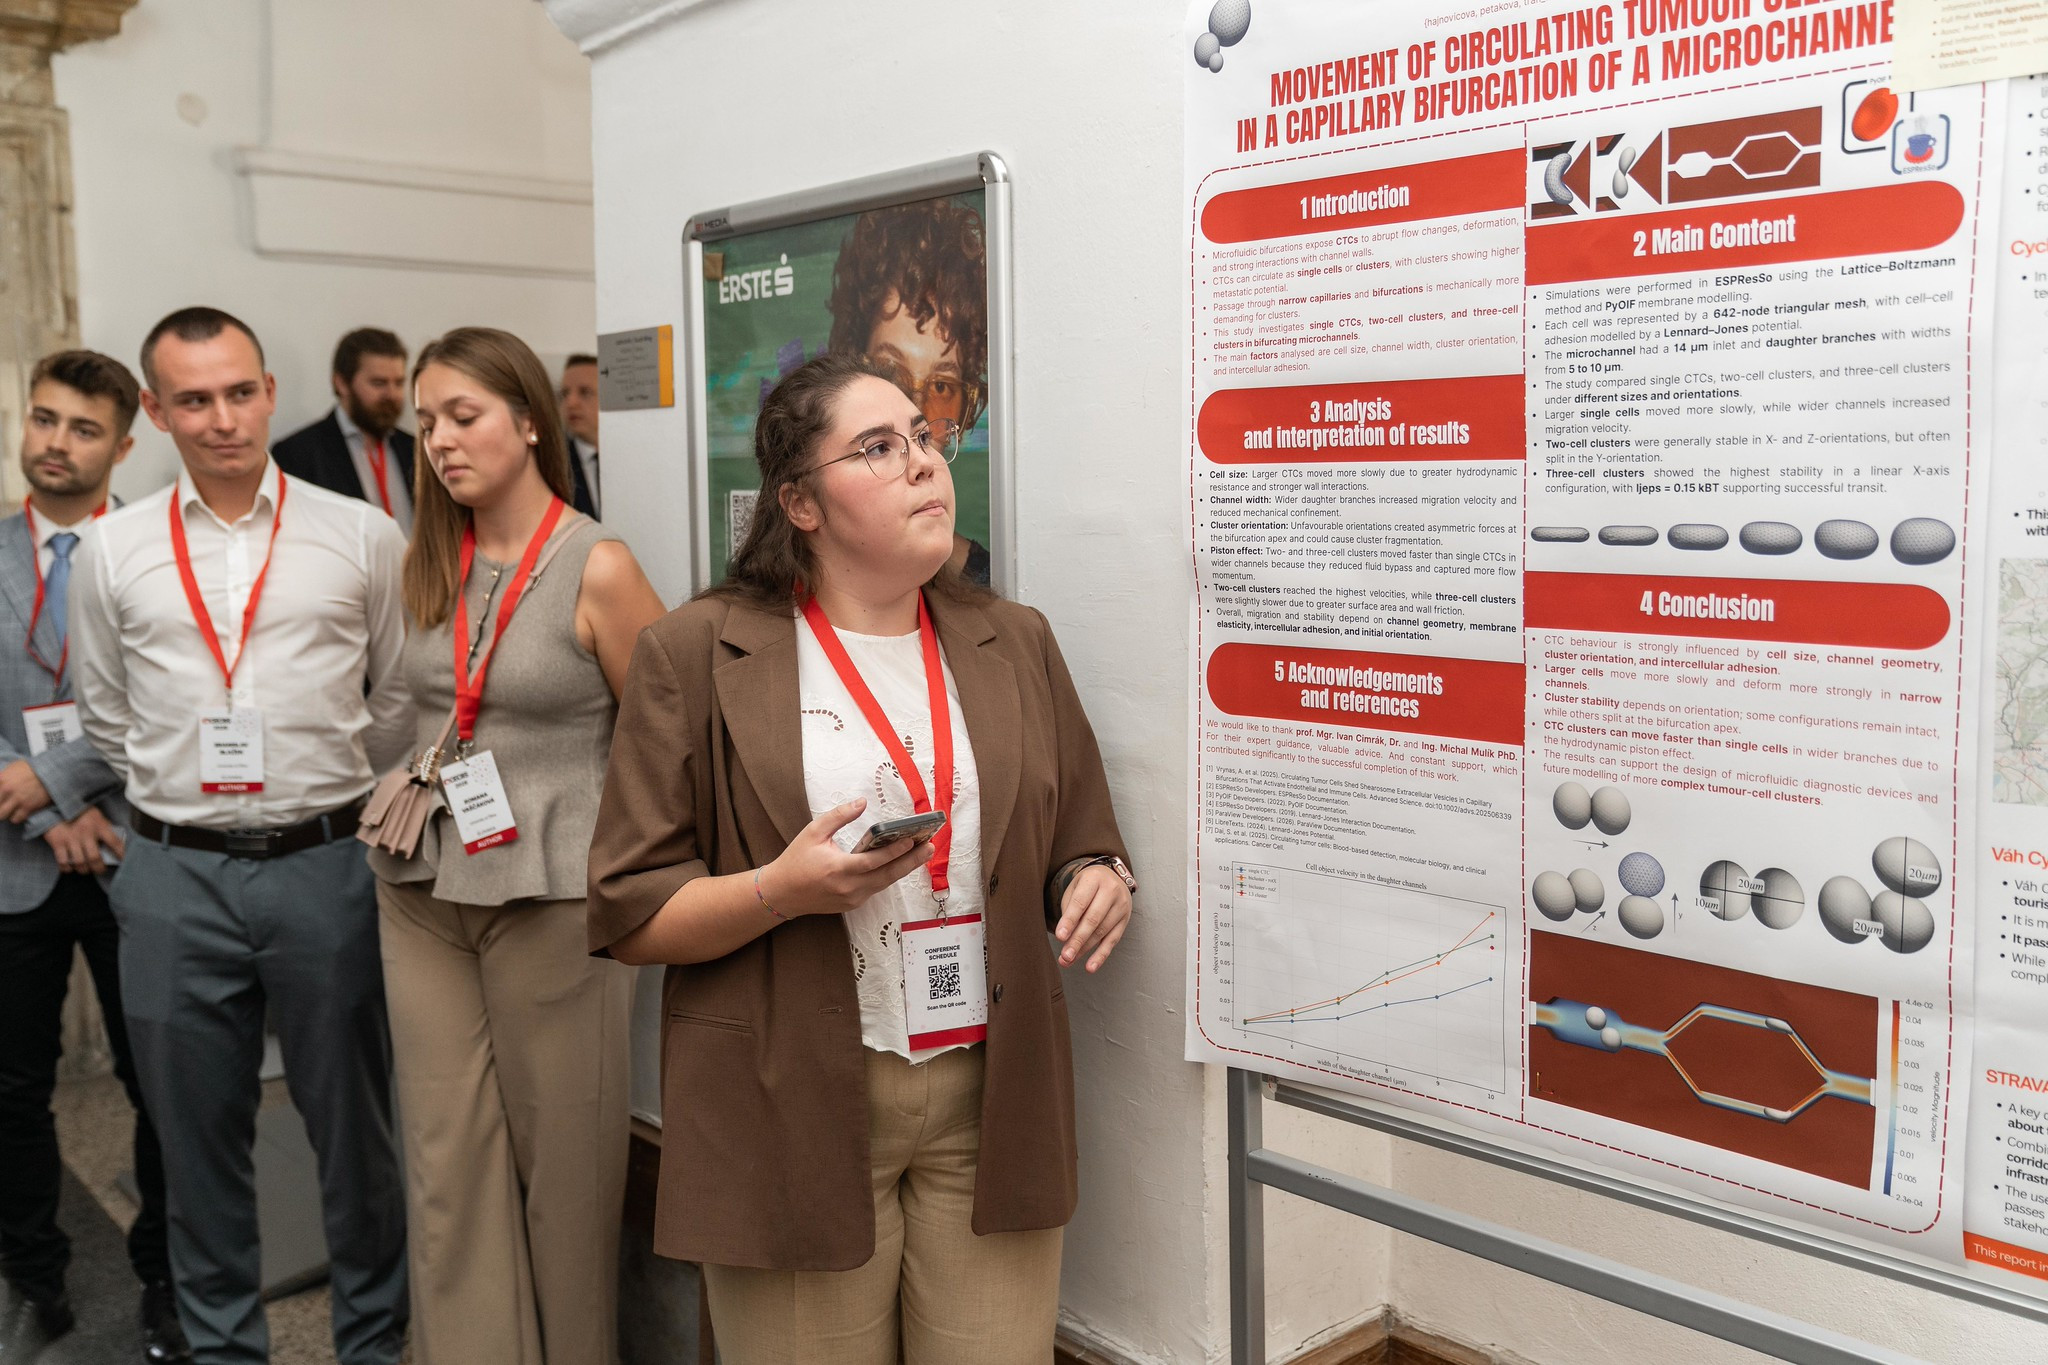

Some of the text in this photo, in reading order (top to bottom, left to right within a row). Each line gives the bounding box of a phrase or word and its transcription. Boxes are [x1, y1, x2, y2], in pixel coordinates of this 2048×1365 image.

[1271, 48, 1399, 107] MOVEMENT
[1407, 41, 1436, 81] OF
[1444, 4, 1612, 73] CIRCULATING
[1237, 116, 1257, 153] IN
[1264, 113, 1278, 148] A
[1285, 90, 1406, 144] CAPILLARY
[1414, 58, 1578, 123] BIFURCATION
[1588, 50, 1622, 93] OF
[1631, 46, 1650, 86] A
[1300, 184, 1409, 219] 1 Introduction
[1212, 216, 1518, 259] Microfluidic bifurcations expose CTCs to abrupt flow changes, deformation,
[1633, 213, 1795, 256] 2 Main Content
[719, 270, 772, 304] ERSTE
[1546, 287, 1600, 300] Simulations
[1606, 286, 1630, 295] were
[1637, 279, 1691, 295] performed
[1699, 278, 1707, 287] in
[1779, 269, 1807, 282] using
[1815, 267, 1833, 277] the
[1213, 331, 1360, 350] clusters in bifurcating microchannels.
[1544, 365, 1565, 374] from
[1568, 364, 1574, 373] 5
[1577, 364, 1587, 373] to
[1590, 362, 1601, 372] 10
[1310, 396, 1391, 425] 3 Analysis
[1243, 420, 1469, 450] and interpretation of results
[1210, 495, 1516, 506] Channel width: Wider daughter branches increased migration velocity and
[1640, 590, 1774, 621] 4 Conclusion
[1544, 634, 1942, 672] CTC behaviour is strongly influenced by cell size, channel geometry,
[1544, 649, 1780, 674] cluster orientation, and intercellular adhesion.
[1274, 660, 1442, 695] 5 Acknowledgements
[1300, 688, 1419, 718] and references
[1206, 719, 1218, 727] We
[1221, 721, 1243, 729] would
[1246, 722, 1259, 731] like
[1261, 724, 1269, 732] to
[1272, 725, 1293, 734] thank
[1296, 728, 1313, 737] prof.
[1316, 729, 1333, 740] Mgr.
[1336, 731, 1353, 741] Ivan
[1389, 737, 1400, 746] Dr.
[1403, 740, 1418, 748] and
[1421, 741, 1437, 752] Ing.
[1440, 743, 1467, 754] Michal
[1497, 750, 1517, 760] PhD.
[477, 834, 503, 848] AUTHOR
[1992, 847, 2024, 864] Váh
[2015, 880, 2038, 893] Váh
[2014, 914, 2033, 927] It is
[2013, 933, 2021, 944] It
[925, 945, 960, 954] CONFERENCE
[929, 952, 957, 960] SCHEDULE
[2012, 952, 2046, 967] While
[1906, 998, 1933, 1009] 4.4e-02
[1906, 1017, 1921, 1025] 0.04
[1905, 1039, 1924, 1048] 0.035
[1904, 1061, 1919, 1069] 0.03
[1904, 1083, 1923, 1092] 0.025
[1903, 1105, 1918, 1114] 0.02
[2008, 1103, 2040, 1120] A key
[1901, 1128, 1920, 1138] 0.015
[1931, 1114, 1939, 1142] velocity
[2008, 1119, 2044, 1135] about
[1900, 1150, 1914, 1159] 0.01
[1898, 1173, 1917, 1183] 0.005
[2005, 1185, 2027, 1199] The
[1896, 1195, 1923, 1207] 2.3e-04
[2005, 1202, 2045, 1219] passes
[1973, 1243, 1997, 1258] This
[2000, 1252, 2037, 1270] report
